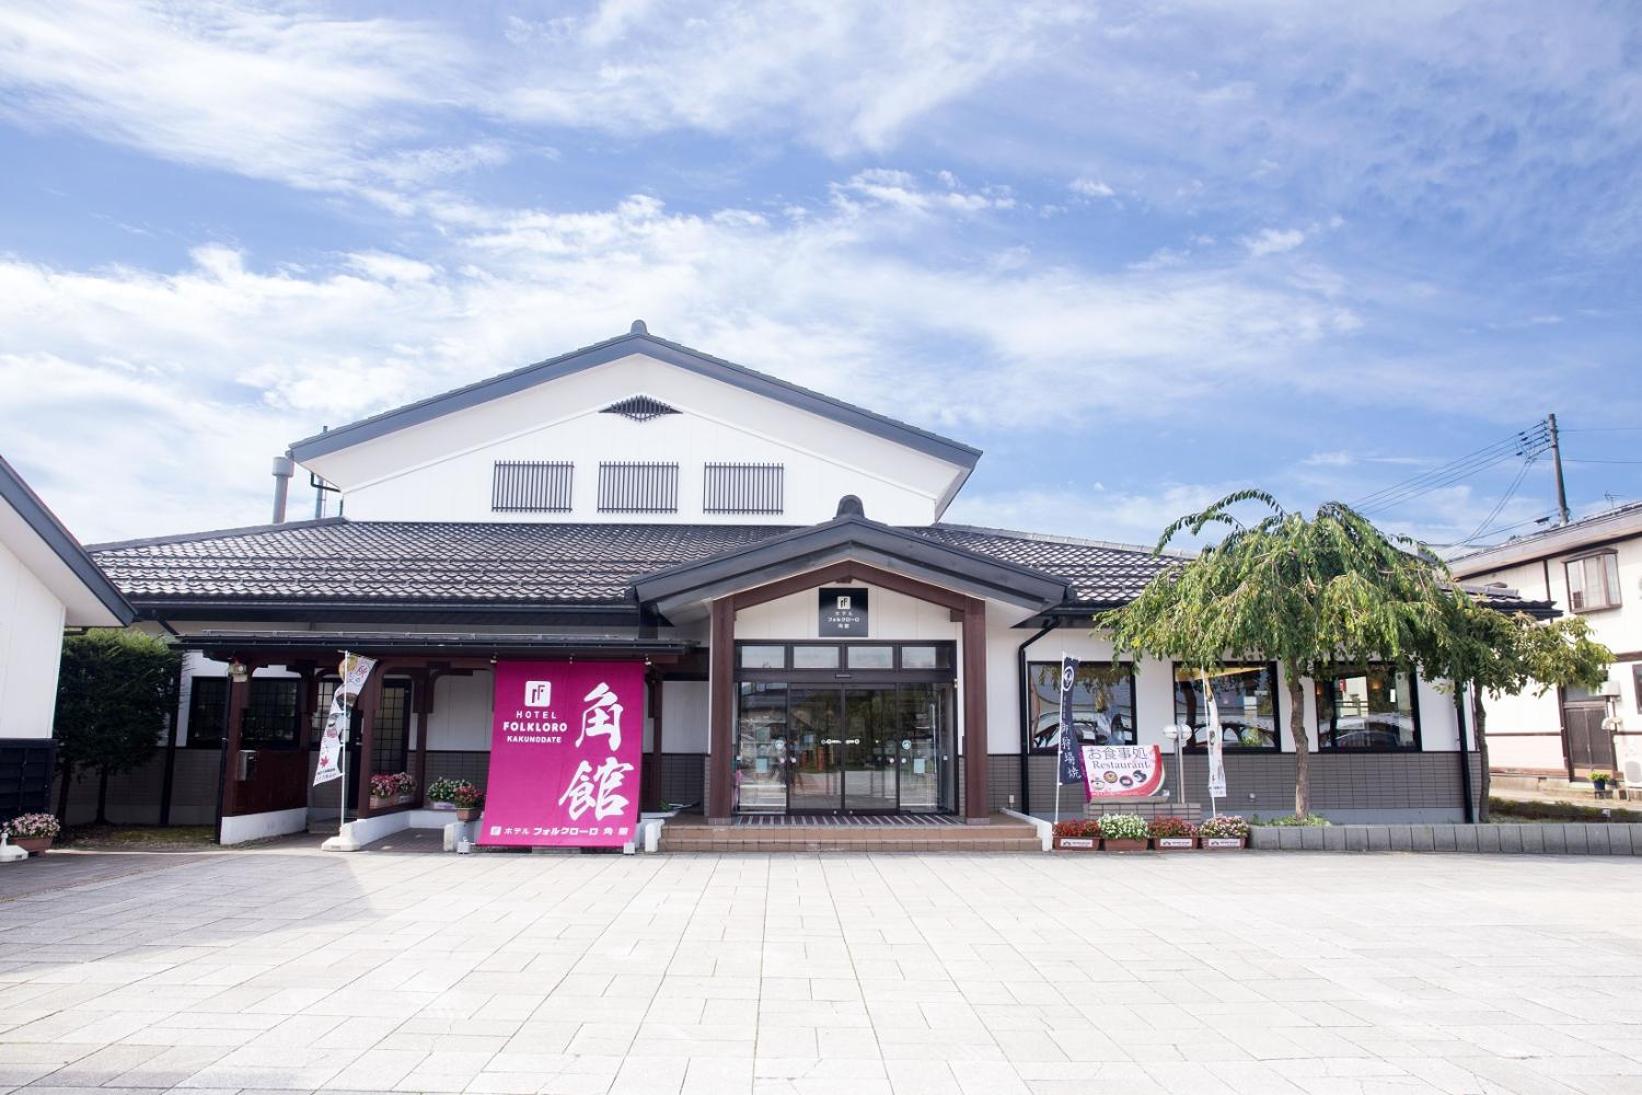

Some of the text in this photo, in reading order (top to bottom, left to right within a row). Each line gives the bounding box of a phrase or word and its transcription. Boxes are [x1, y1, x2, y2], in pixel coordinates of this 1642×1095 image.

[516, 711, 557, 719] HOTEL
[503, 722, 568, 732] FOLKLORO
[507, 735, 561, 744] KAKUNODATE
[558, 681, 635, 821] 角館
[1087, 746, 1149, 760] お食事処
[1092, 760, 1151, 770] Restaurant
[504, 827, 529, 835] ホテル
[533, 827, 599, 836] フォルクローロ
